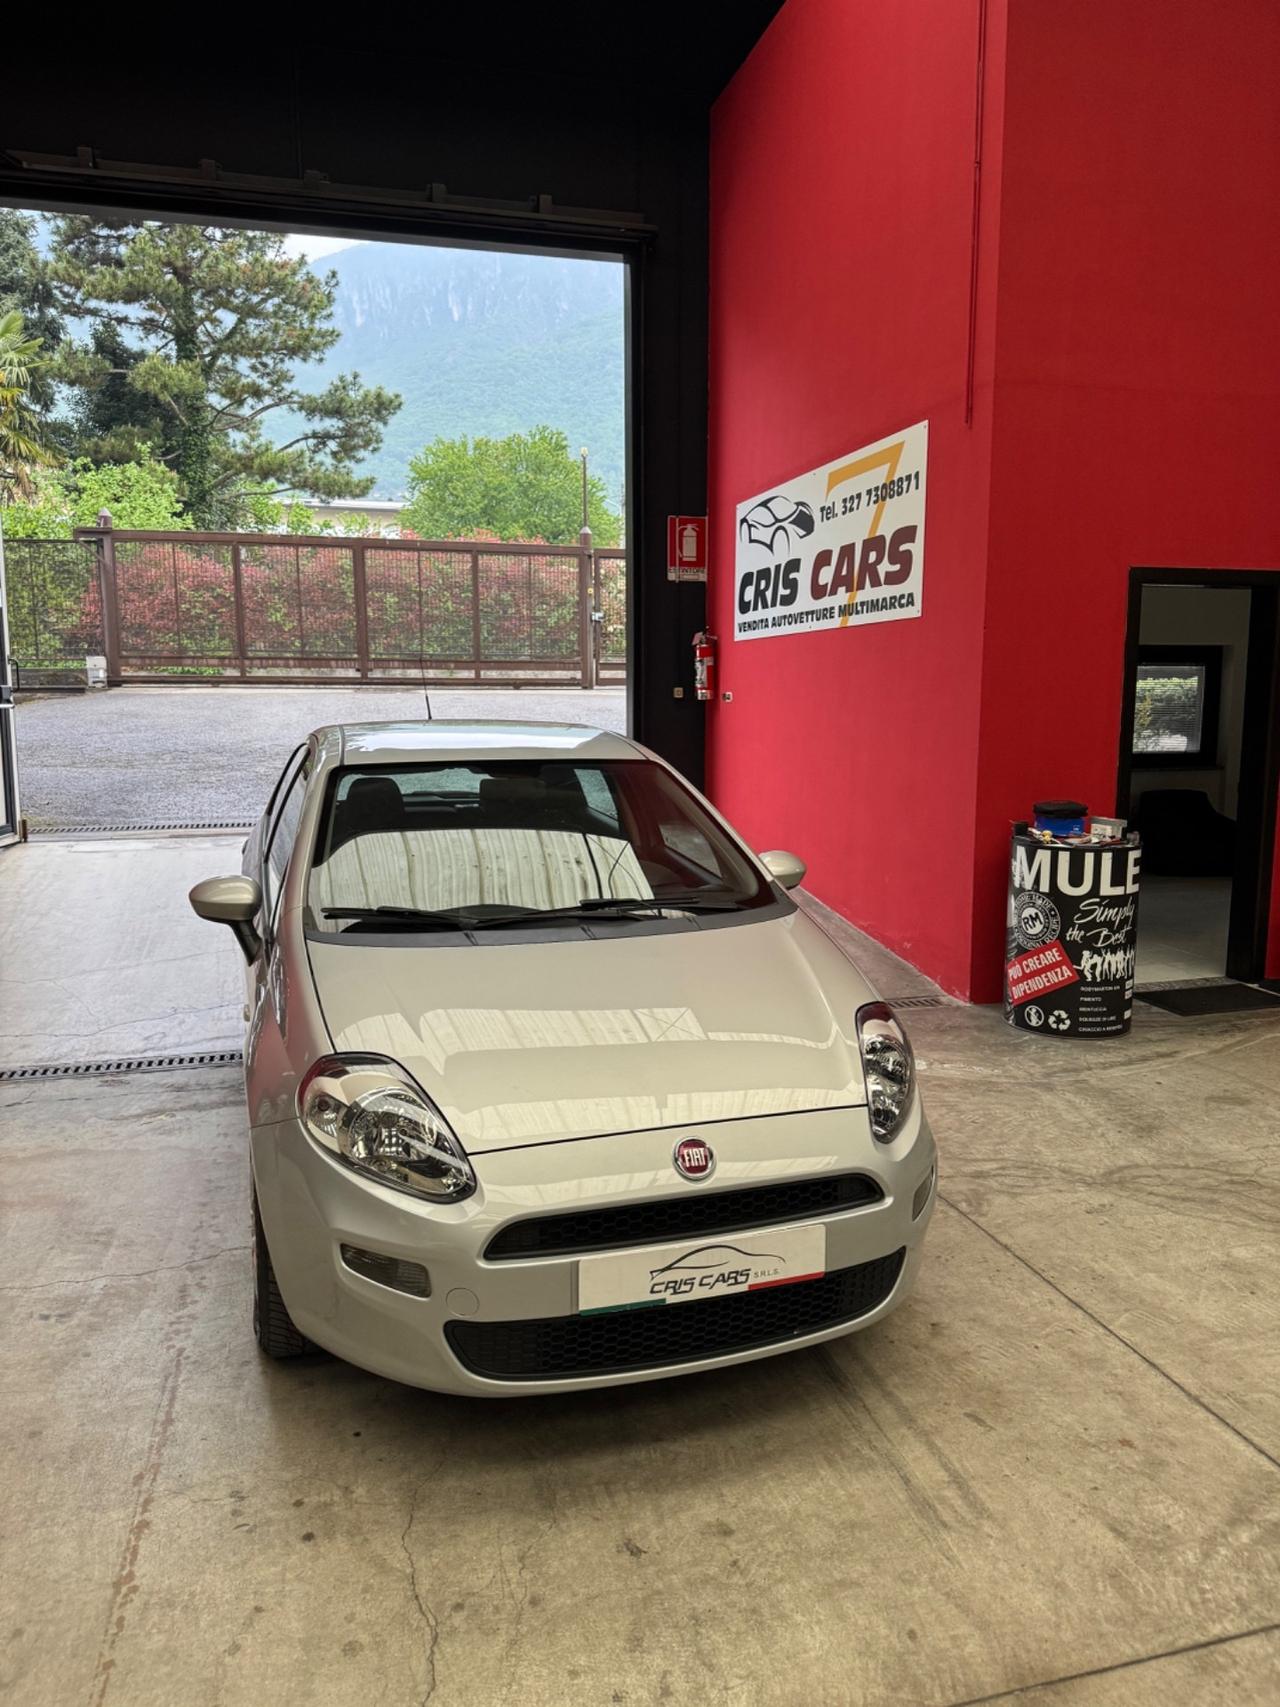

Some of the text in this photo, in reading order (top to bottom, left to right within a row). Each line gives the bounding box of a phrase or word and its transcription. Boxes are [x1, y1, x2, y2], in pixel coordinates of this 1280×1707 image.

[819, 470, 920, 523] Tel. 327 7308871
[738, 525, 918, 615] CRIS CARS
[738, 592, 915, 633] VENDITA AUTOVETTURE MULTIMARCA
[1012, 845, 1141, 896] MULE
[1022, 912, 1043, 931] RM
[1073, 896, 1135, 930] Simply
[1066, 924, 1132, 947] the Best
[1022, 948, 1063, 973] CREARE
[1012, 965, 1073, 999] DIPENDENZA
[683, 1147, 706, 1167] FIAT
[649, 1277, 696, 1296] CRIS
[698, 1268, 752, 1290] CARS
